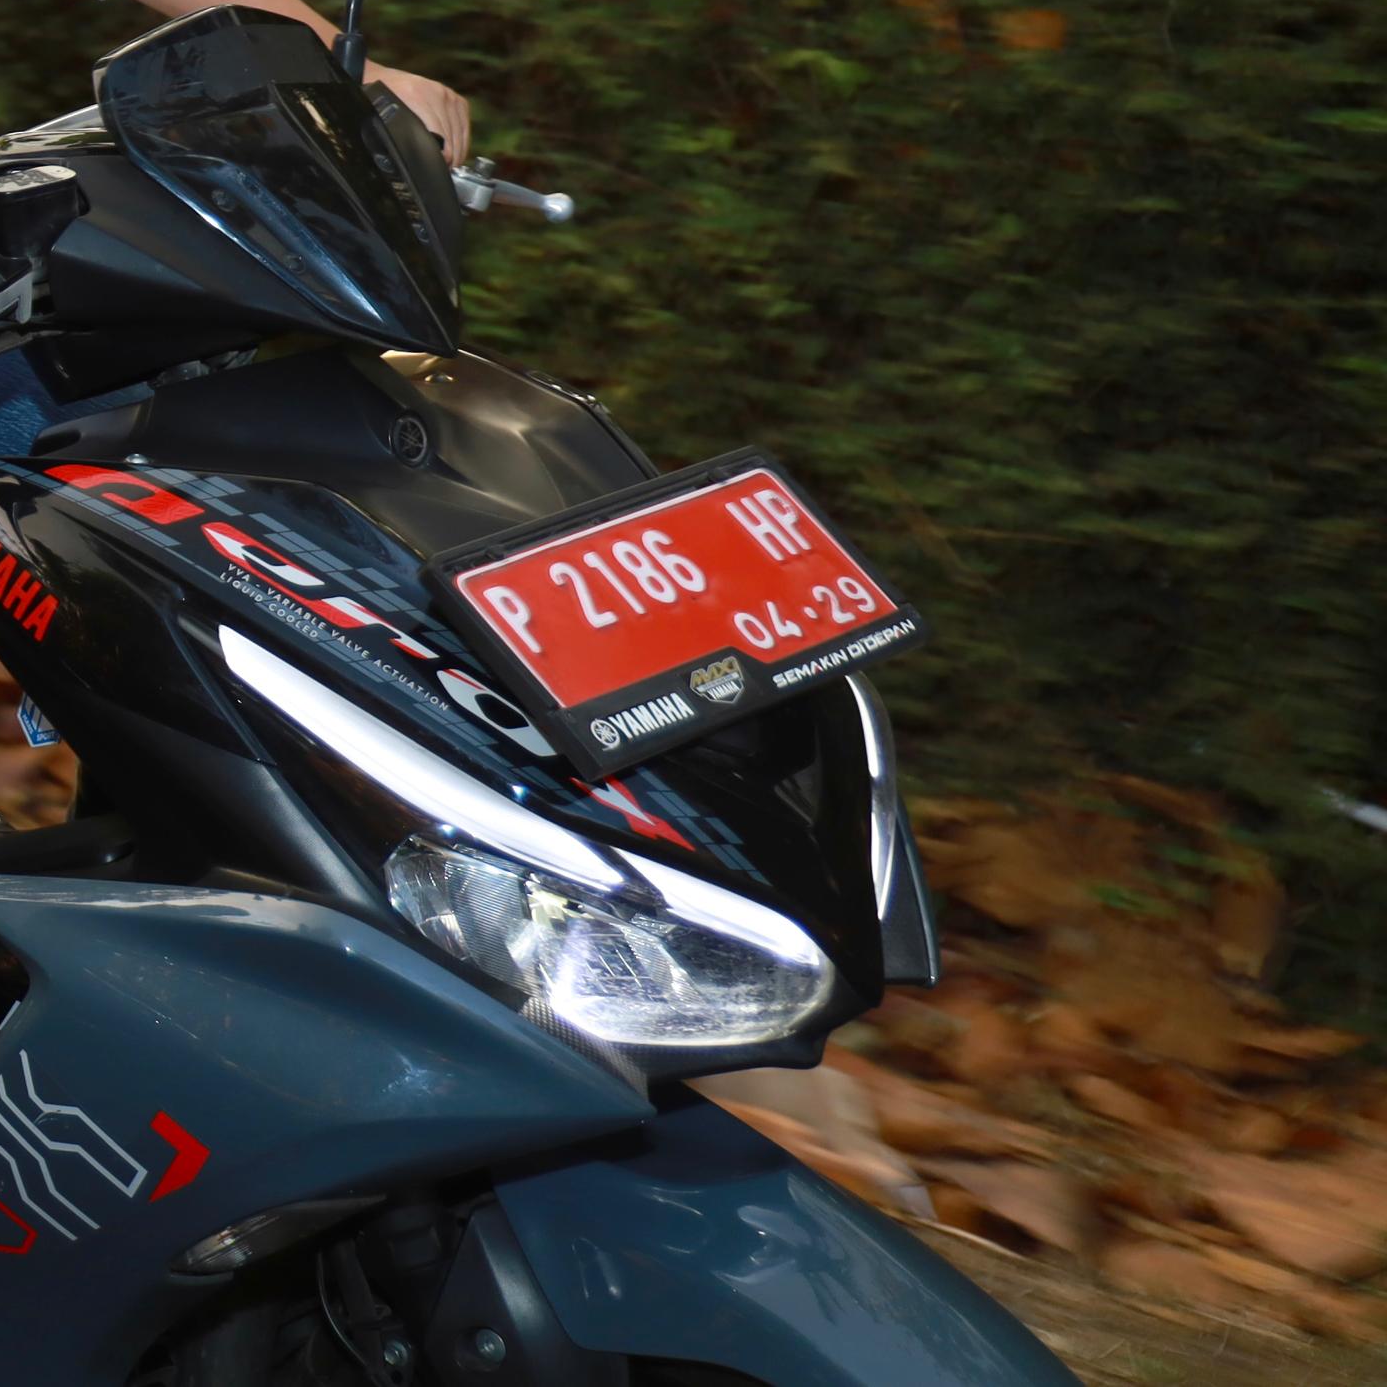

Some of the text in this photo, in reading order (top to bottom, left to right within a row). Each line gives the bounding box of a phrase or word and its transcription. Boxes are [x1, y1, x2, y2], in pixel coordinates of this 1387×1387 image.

[482, 489, 811, 654] P 2186 HP
[219, 572, 319, 640] LIQUID COOLED
[228, 563, 251, 583] VVA
[267, 587, 326, 630] VARIABLE
[331, 629, 370, 658] VALVE
[373, 659, 449, 711] ACTUATION
[861, 618, 917, 652] DEPAN
[607, 692, 695, 739] YAMAHA
[707, 680, 740, 699] YAMAHA
